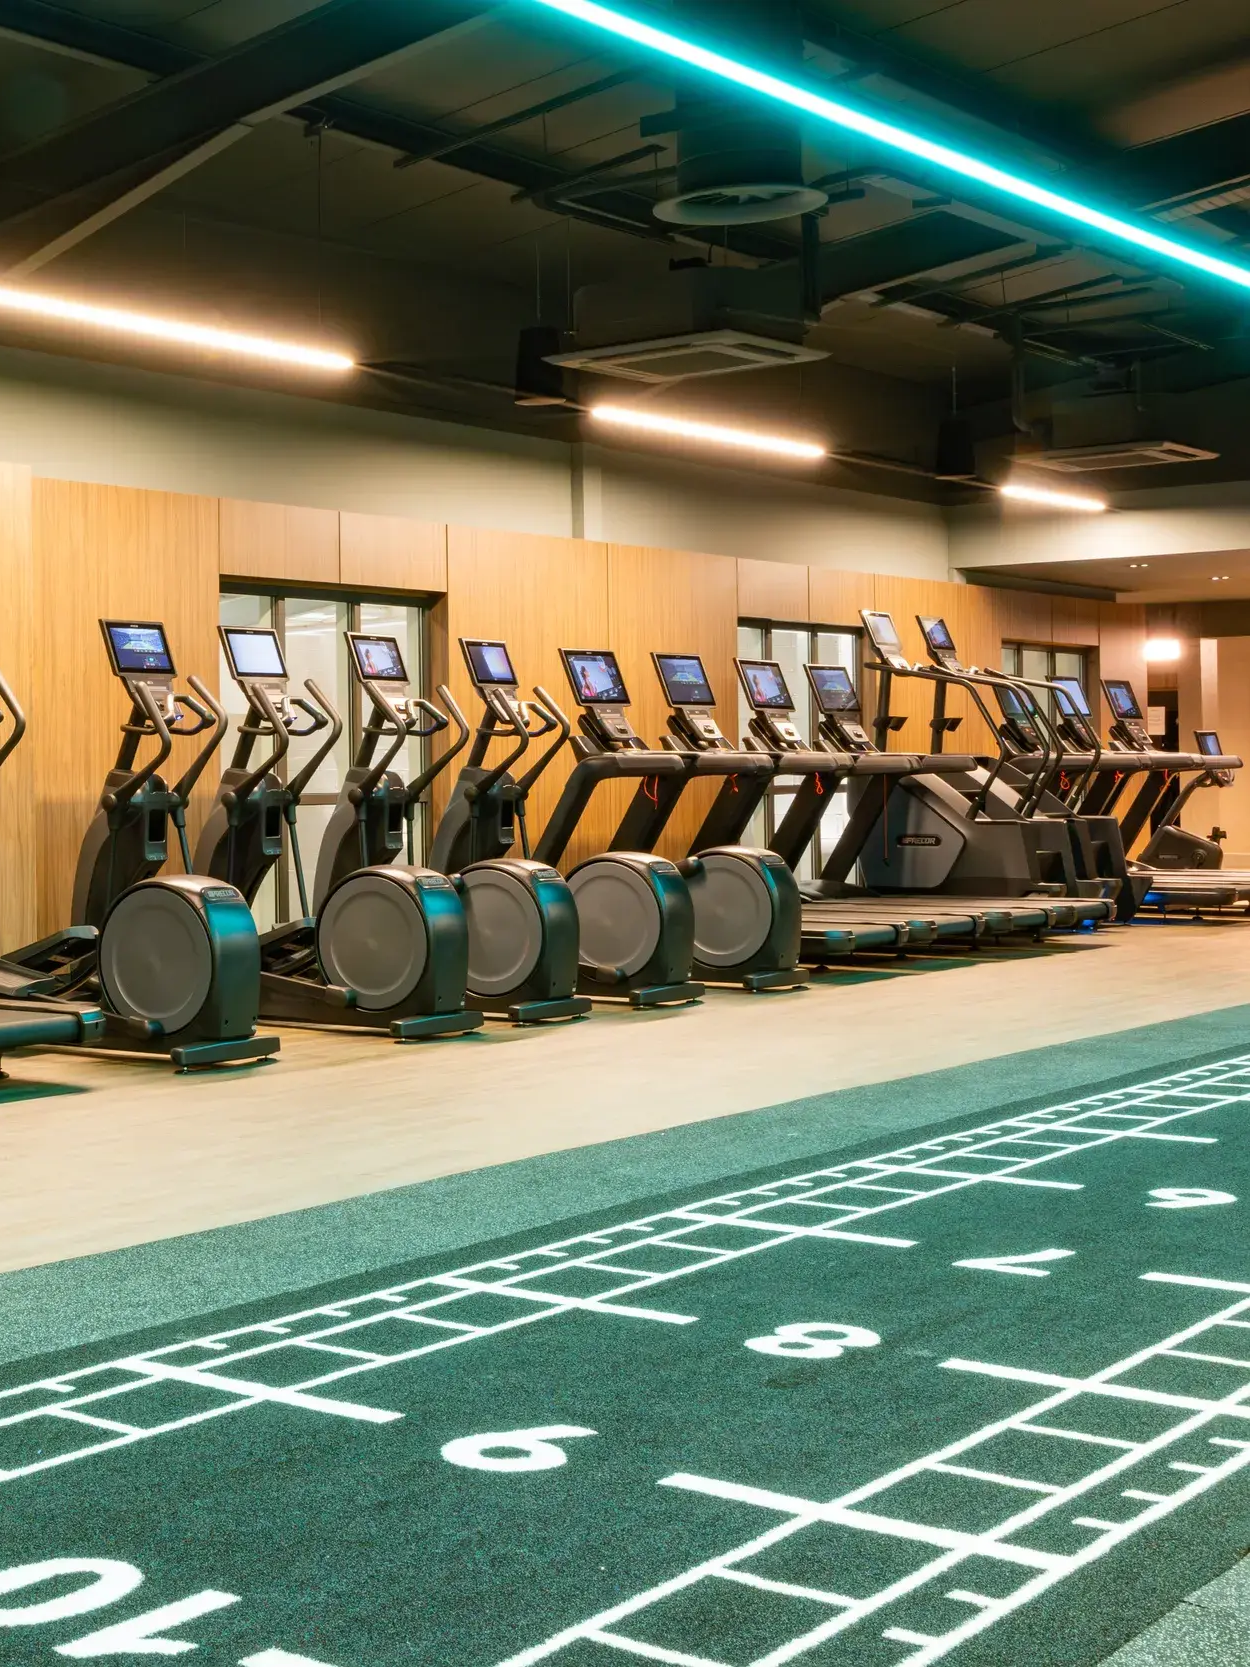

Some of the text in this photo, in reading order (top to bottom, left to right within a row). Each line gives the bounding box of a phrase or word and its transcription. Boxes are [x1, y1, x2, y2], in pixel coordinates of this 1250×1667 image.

[906, 837, 936, 845] PRECOR
[952, 1248, 1076, 1277] 7
[744, 1322, 881, 1358] 8
